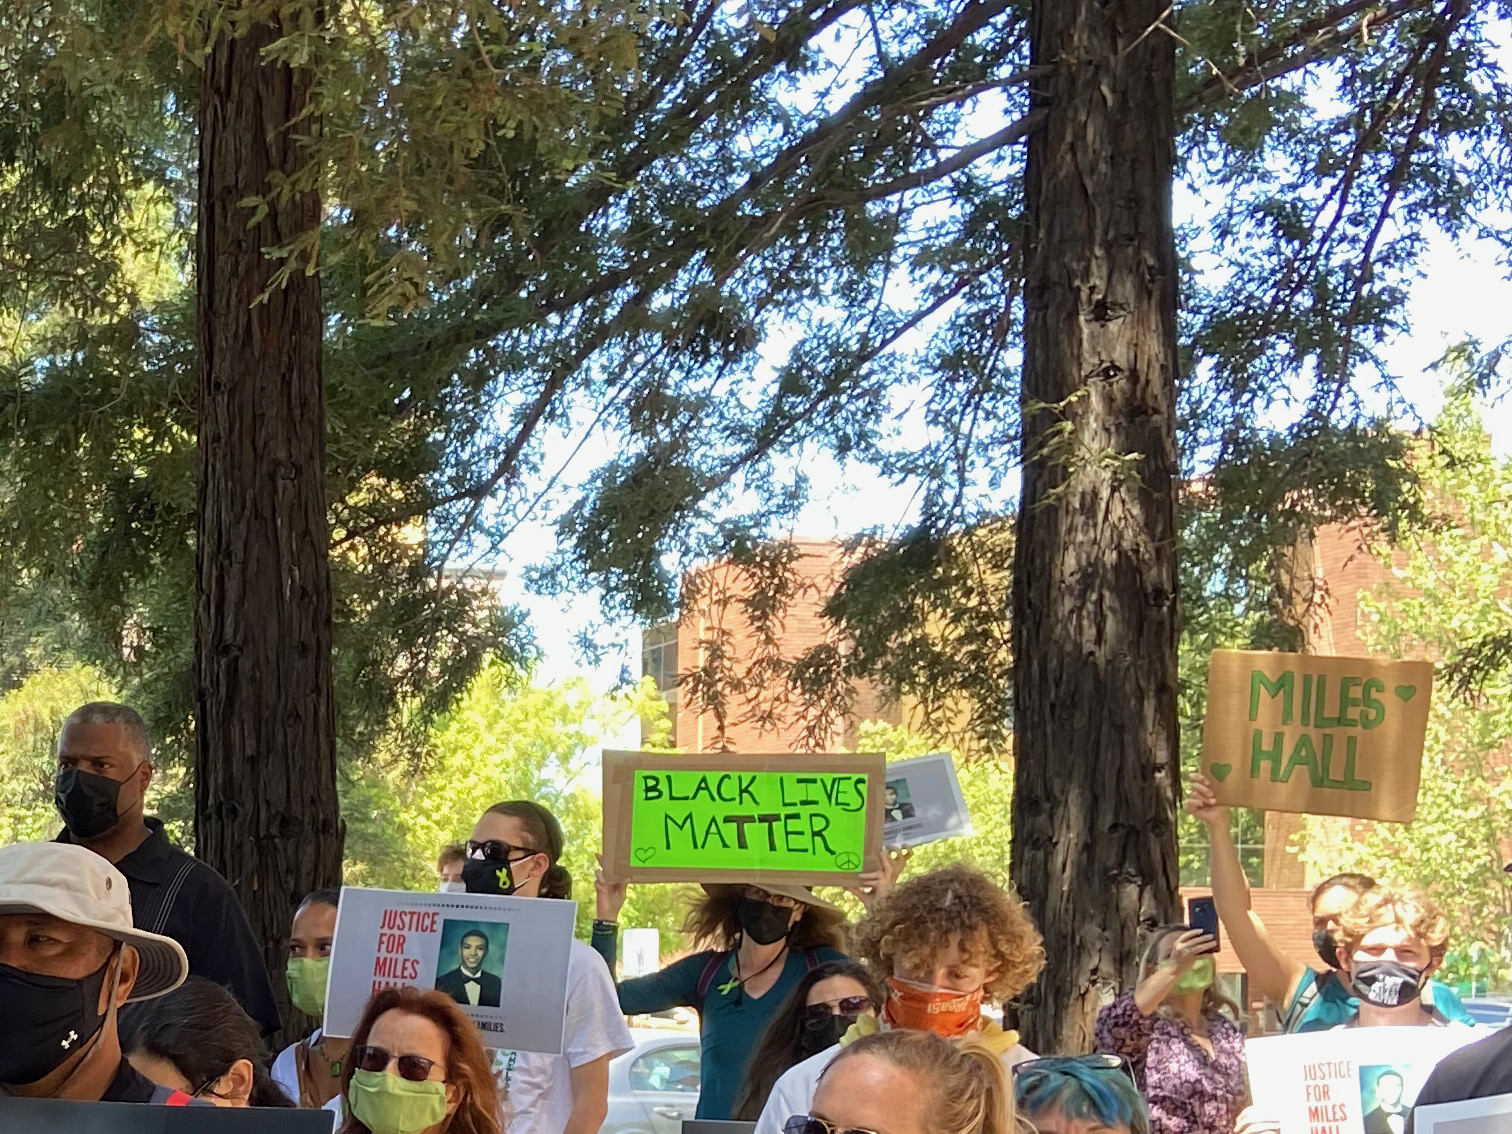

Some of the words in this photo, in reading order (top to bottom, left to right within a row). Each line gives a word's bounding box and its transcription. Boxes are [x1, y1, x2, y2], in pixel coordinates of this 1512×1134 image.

[1249, 670, 1386, 730] MILES
[1250, 729, 1373, 791] HALL
[643, 774, 760, 806] BLACK
[779, 776, 867, 812] LIVES
[665, 812, 837, 856] MATTER
[380, 909, 439, 933] JUSTICE
[376, 933, 406, 956] FOR
[374, 956, 420, 981] MILES
[1303, 1060, 1352, 1081] JUSTICE
[1305, 1083, 1331, 1102] FOR
[1308, 1103, 1348, 1123] MILES
